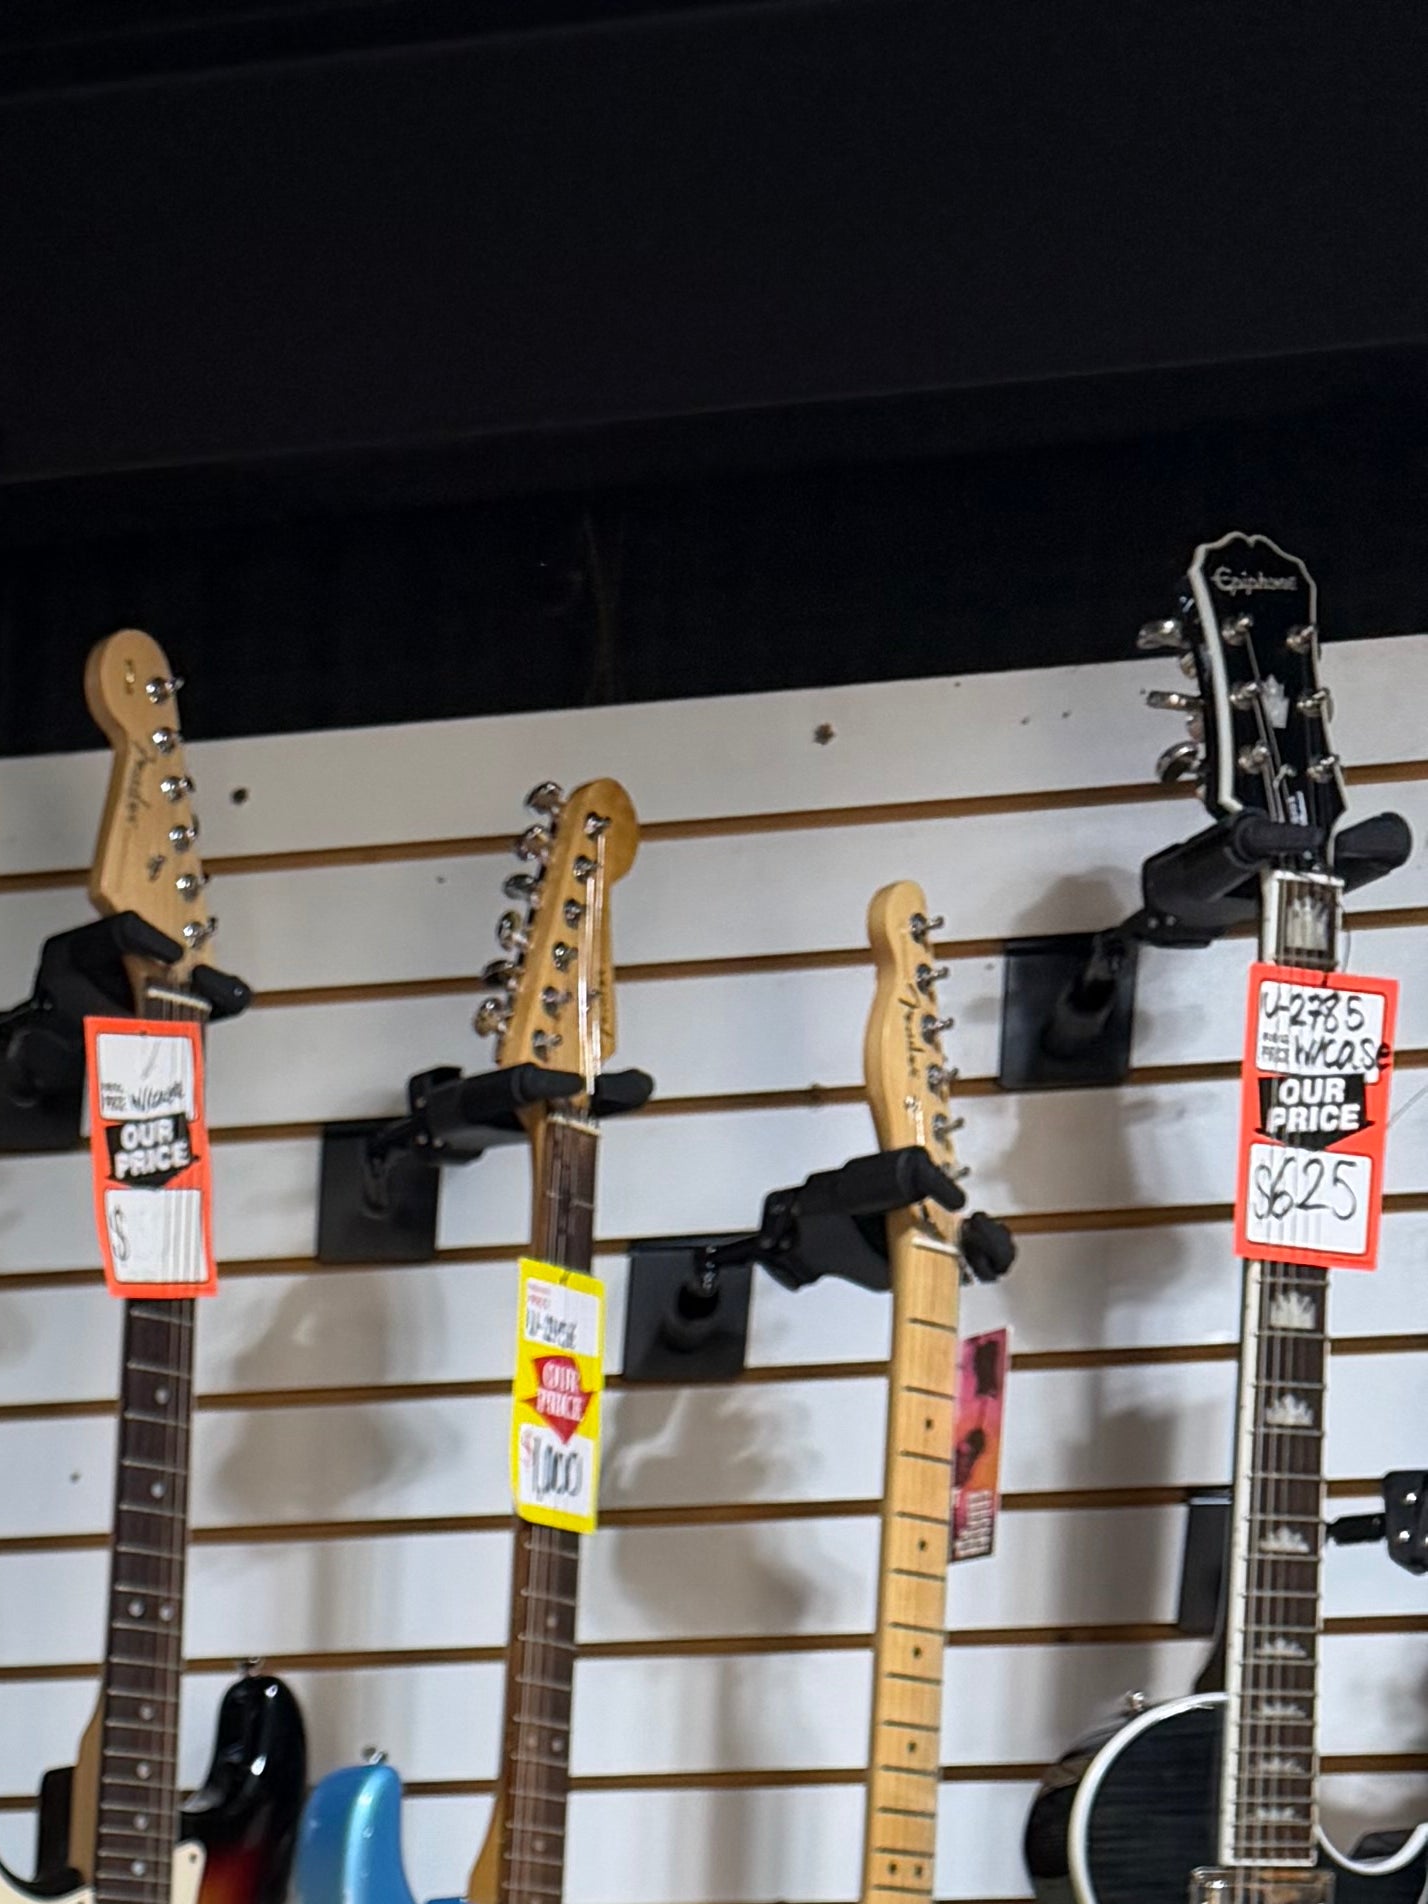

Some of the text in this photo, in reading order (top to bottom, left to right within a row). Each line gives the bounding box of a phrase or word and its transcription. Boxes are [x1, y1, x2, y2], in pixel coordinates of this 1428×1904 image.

[1212, 566, 1298, 596] Epiphone
[1279, 1077, 1347, 1106] OUR
[1266, 1103, 1362, 1134] PRICE
[120, 1119, 175, 1150] OUR
[114, 1141, 191, 1181] PRICE
[1253, 1156, 1358, 1222] $625
[543, 1361, 580, 1392] OUR
[536, 1389, 584, 1422] PRICE
